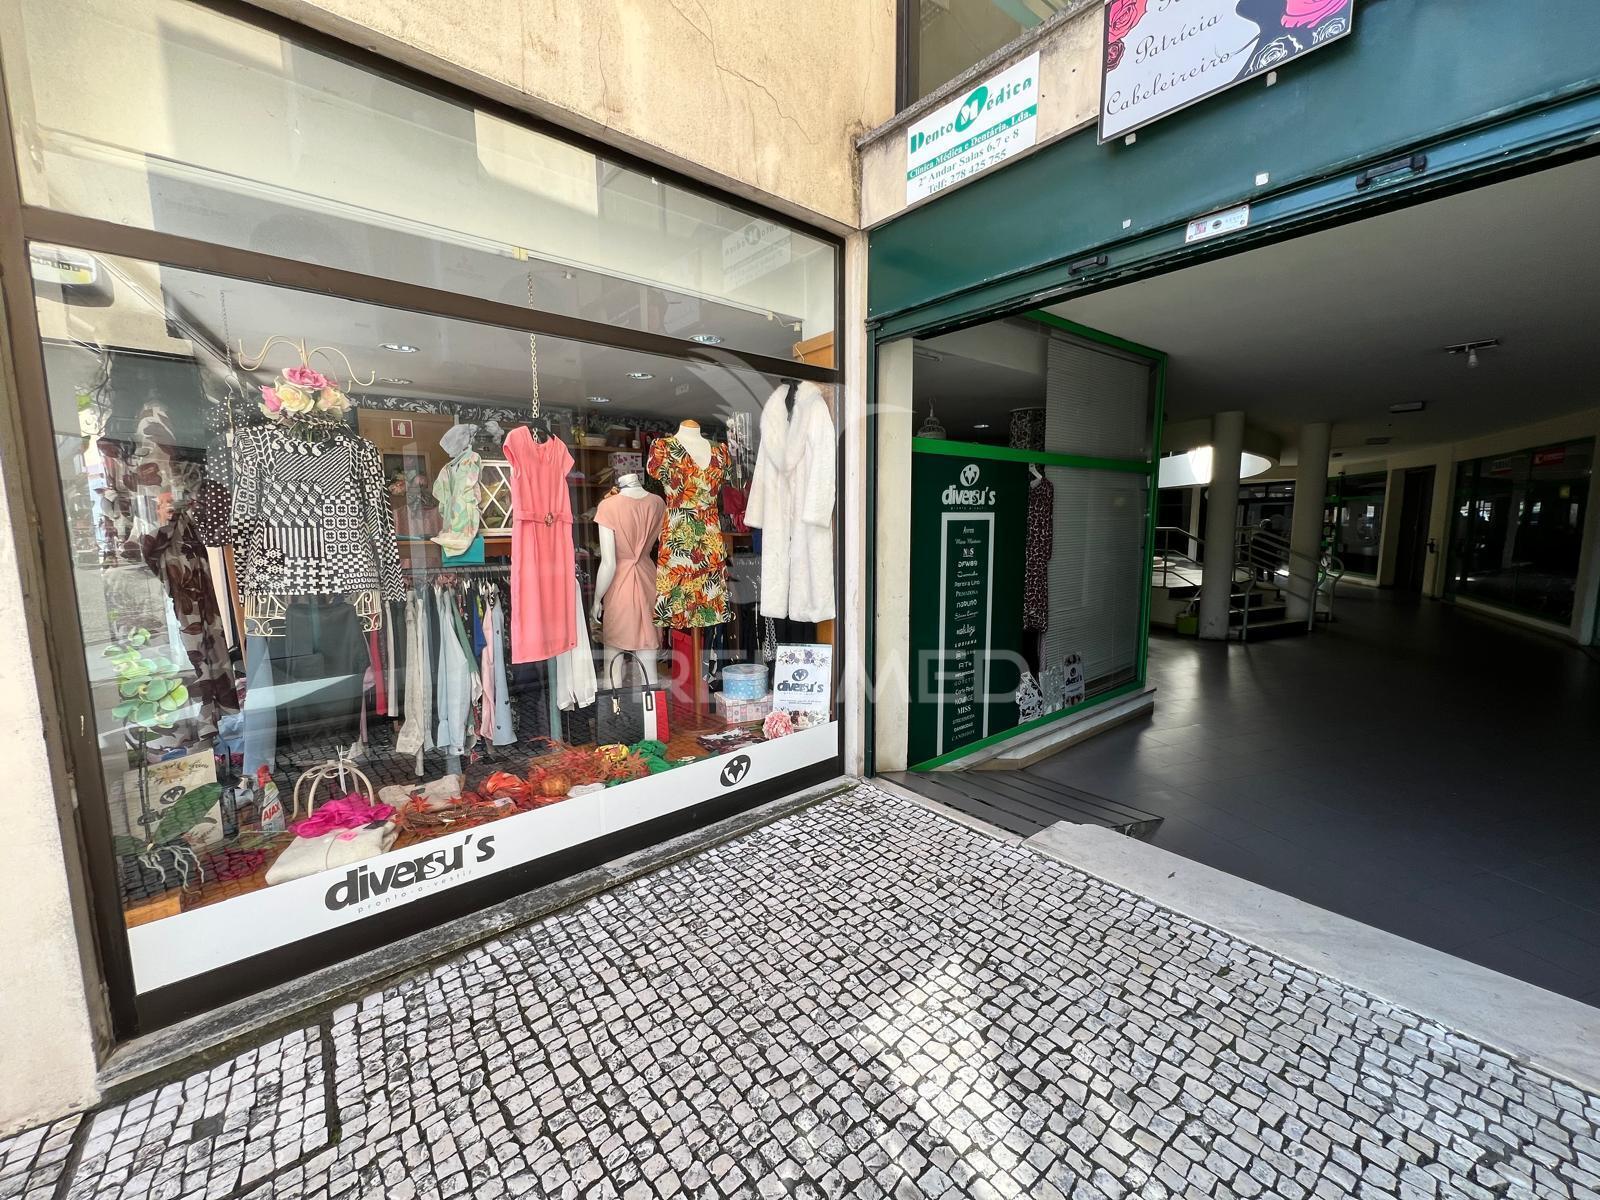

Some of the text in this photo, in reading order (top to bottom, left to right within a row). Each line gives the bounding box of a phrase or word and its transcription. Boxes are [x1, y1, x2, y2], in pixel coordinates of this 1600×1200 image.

[1136, 13, 1223, 64] Patrícia
[1106, 50, 1231, 115] Cabeleireiro
[910, 123, 953, 154] Dento
[909, 161, 934, 178] Clínica
[935, 147, 963, 166] Médica
[928, 162, 956, 183] Andar
[959, 148, 984, 167] Salas
[1004, 134, 1011, 143] e
[1012, 128, 1020, 140] 8
[950, 169, 966, 183] 278
[968, 158, 986, 175] 425
[988, 148, 1008, 164] 755
[942, 484, 996, 506] diversu's
[957, 704, 972, 714] MISS
[263, 803, 280, 821] AJAX
[324, 834, 496, 911] diversu's
